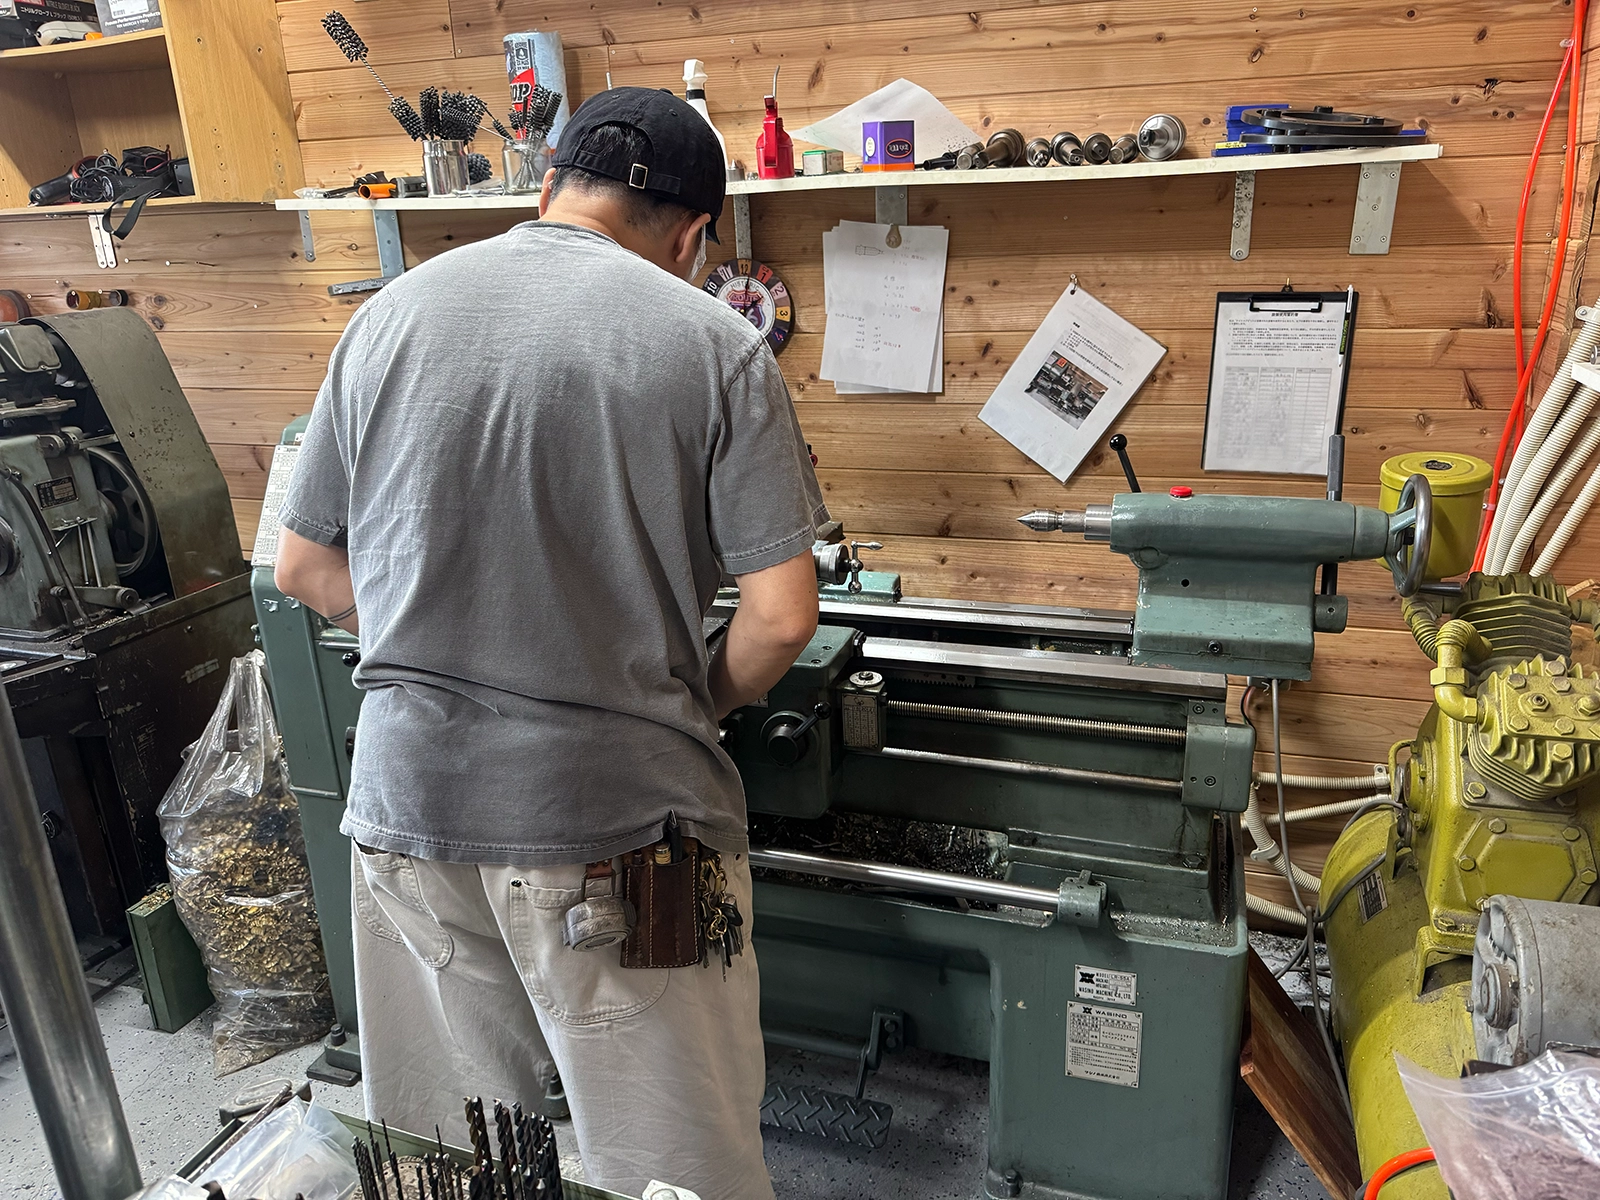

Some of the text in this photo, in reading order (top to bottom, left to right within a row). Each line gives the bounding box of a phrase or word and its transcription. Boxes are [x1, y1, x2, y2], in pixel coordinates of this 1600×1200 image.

[741, 264, 749, 275] 12
[707, 281, 718, 293] 10
[775, 285, 784, 296] 2
[732, 294, 758, 302] ROUTE
[779, 309, 788, 317] 3
[1096, 1009, 1127, 1018] WASINO
